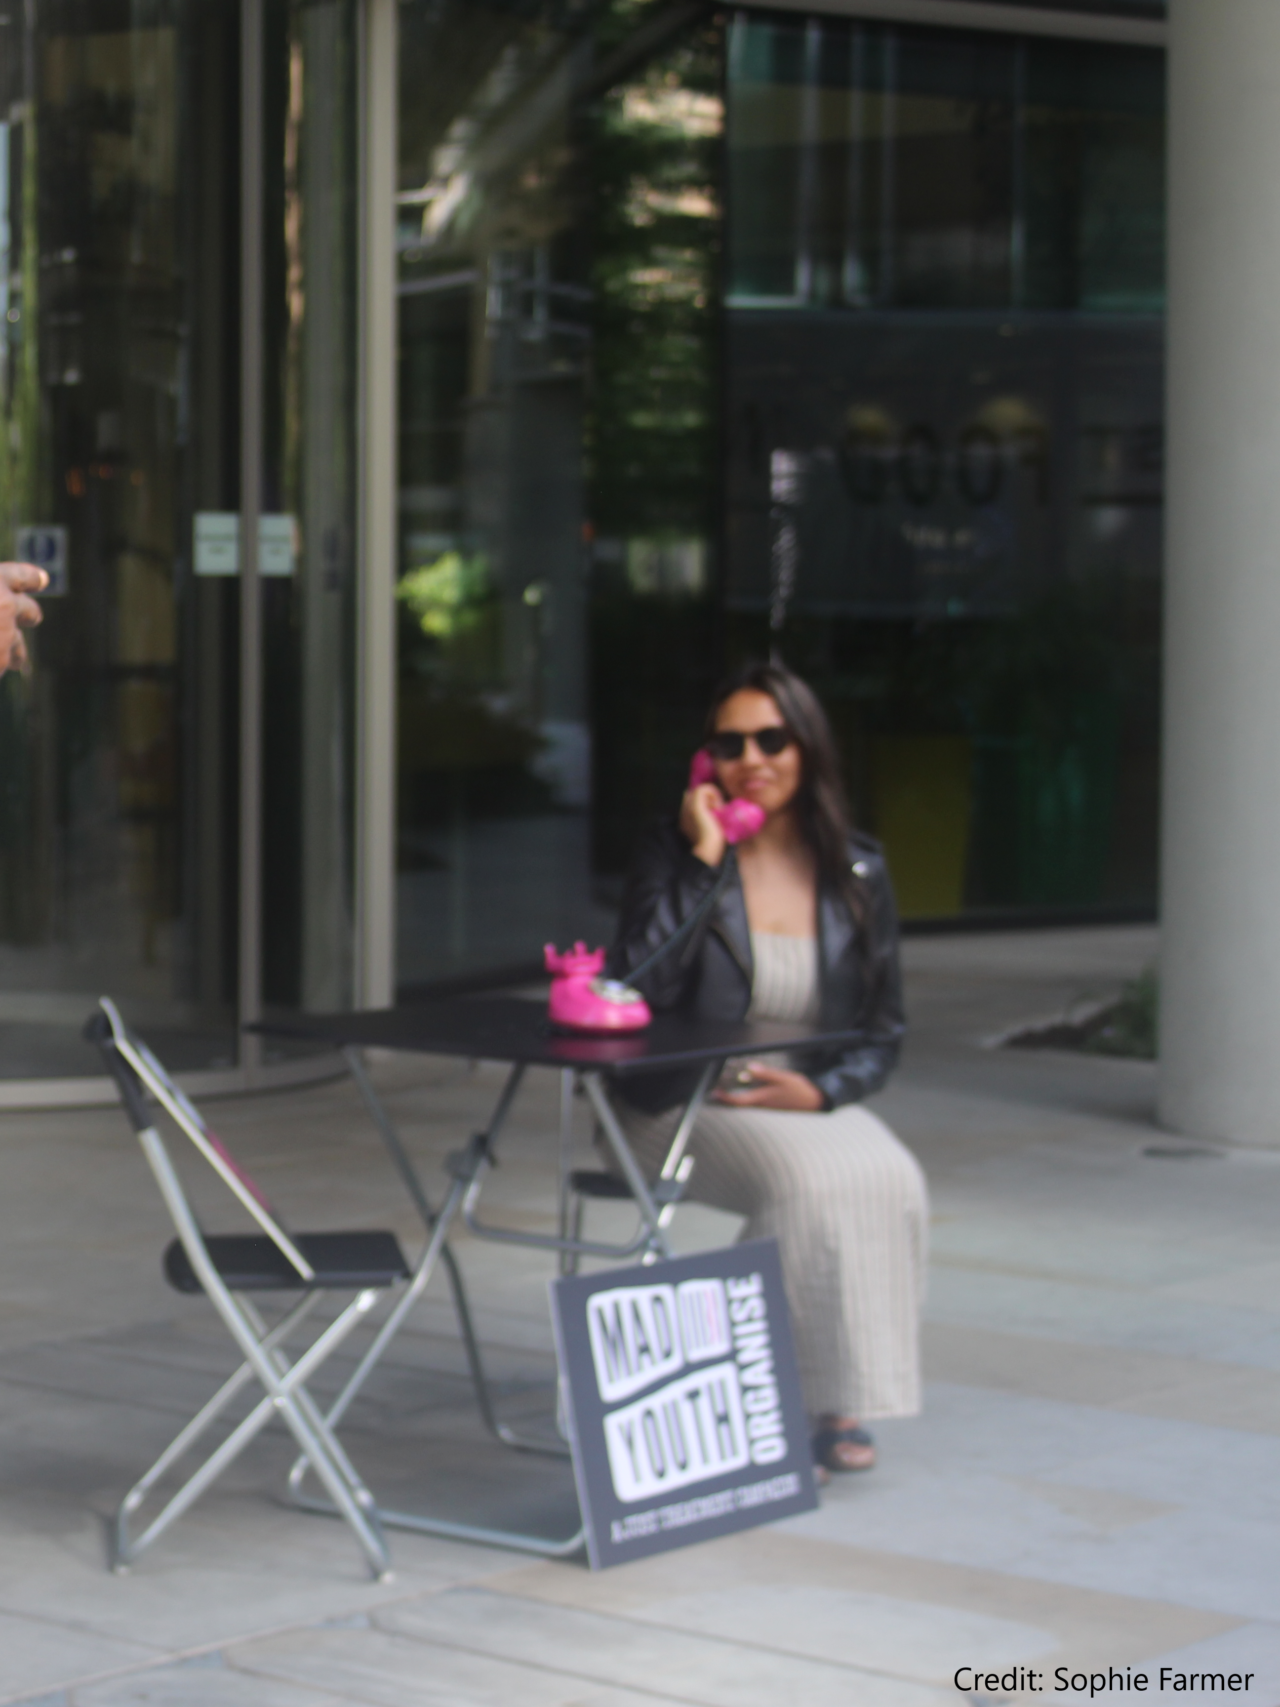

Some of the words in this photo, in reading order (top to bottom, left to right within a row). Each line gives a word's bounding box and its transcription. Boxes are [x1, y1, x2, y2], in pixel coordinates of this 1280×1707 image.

[595, 1292, 674, 1387] MAD
[725, 1273, 788, 1466] ORGANISE
[616, 1377, 740, 1485] YOUTH
